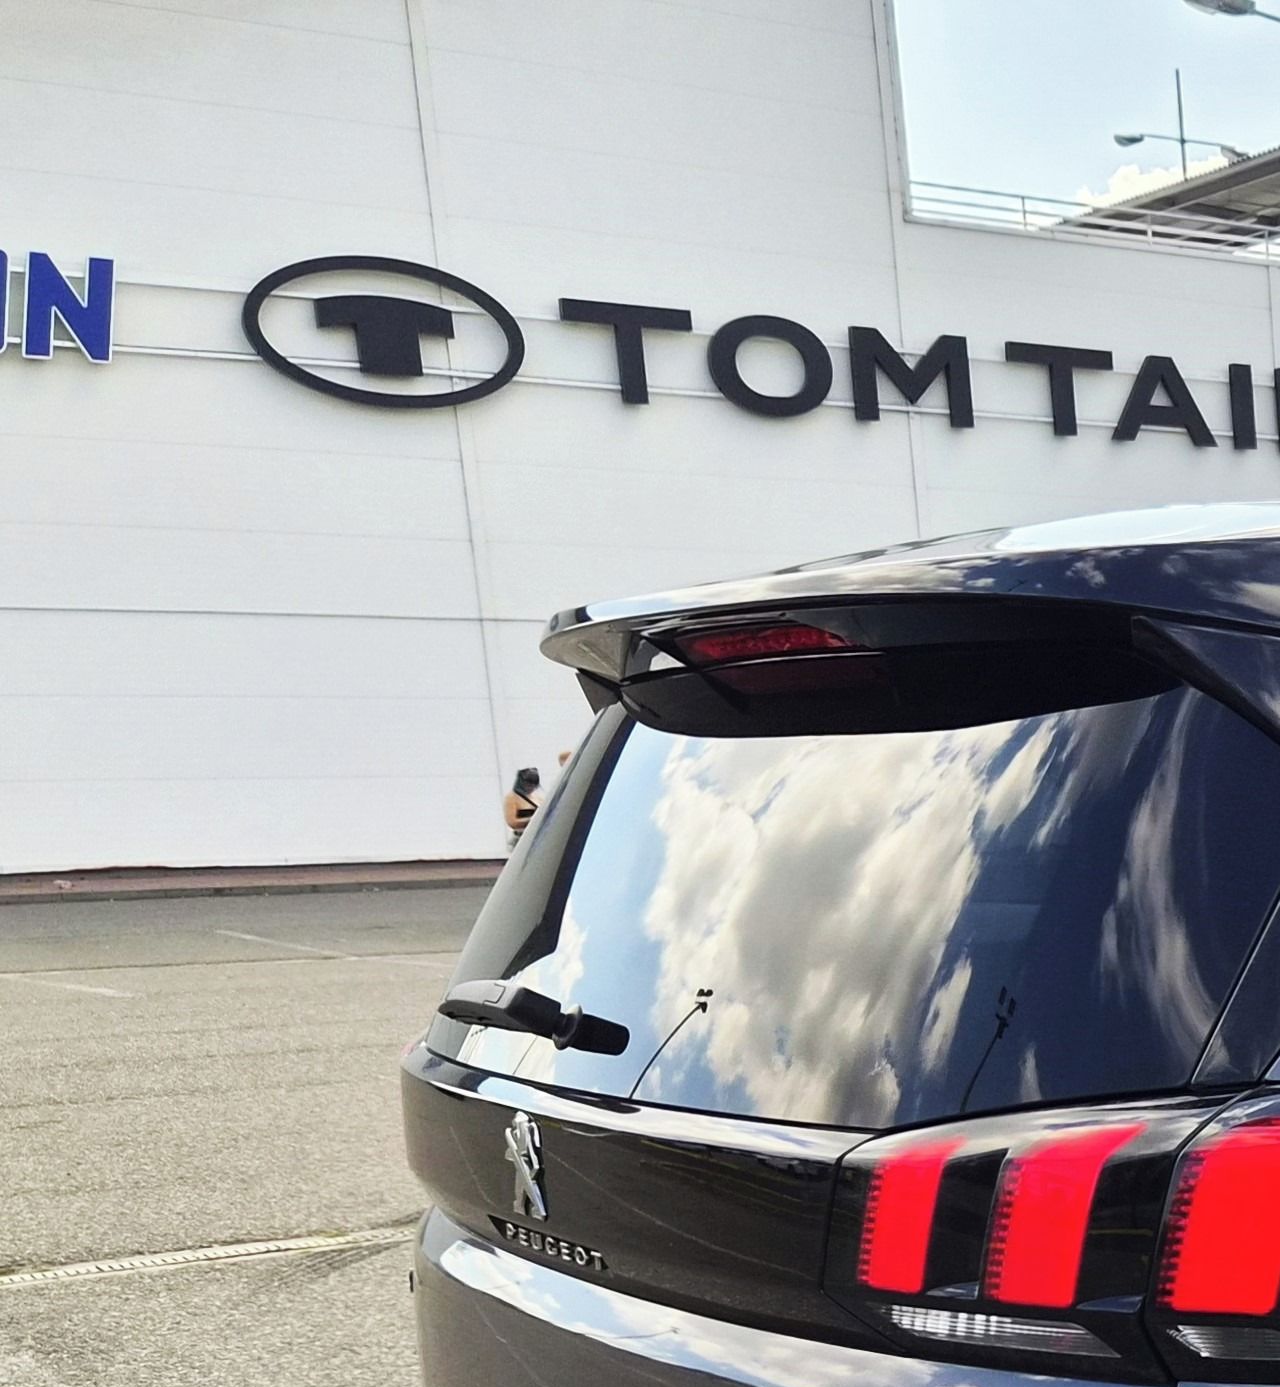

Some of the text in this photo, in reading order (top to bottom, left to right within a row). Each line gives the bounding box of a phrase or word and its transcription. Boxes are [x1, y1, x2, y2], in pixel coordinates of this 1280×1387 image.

[0, 249, 115, 363] N
[558, 297, 975, 429] TOM
[505, 1222, 603, 1271] PEUGEOT
